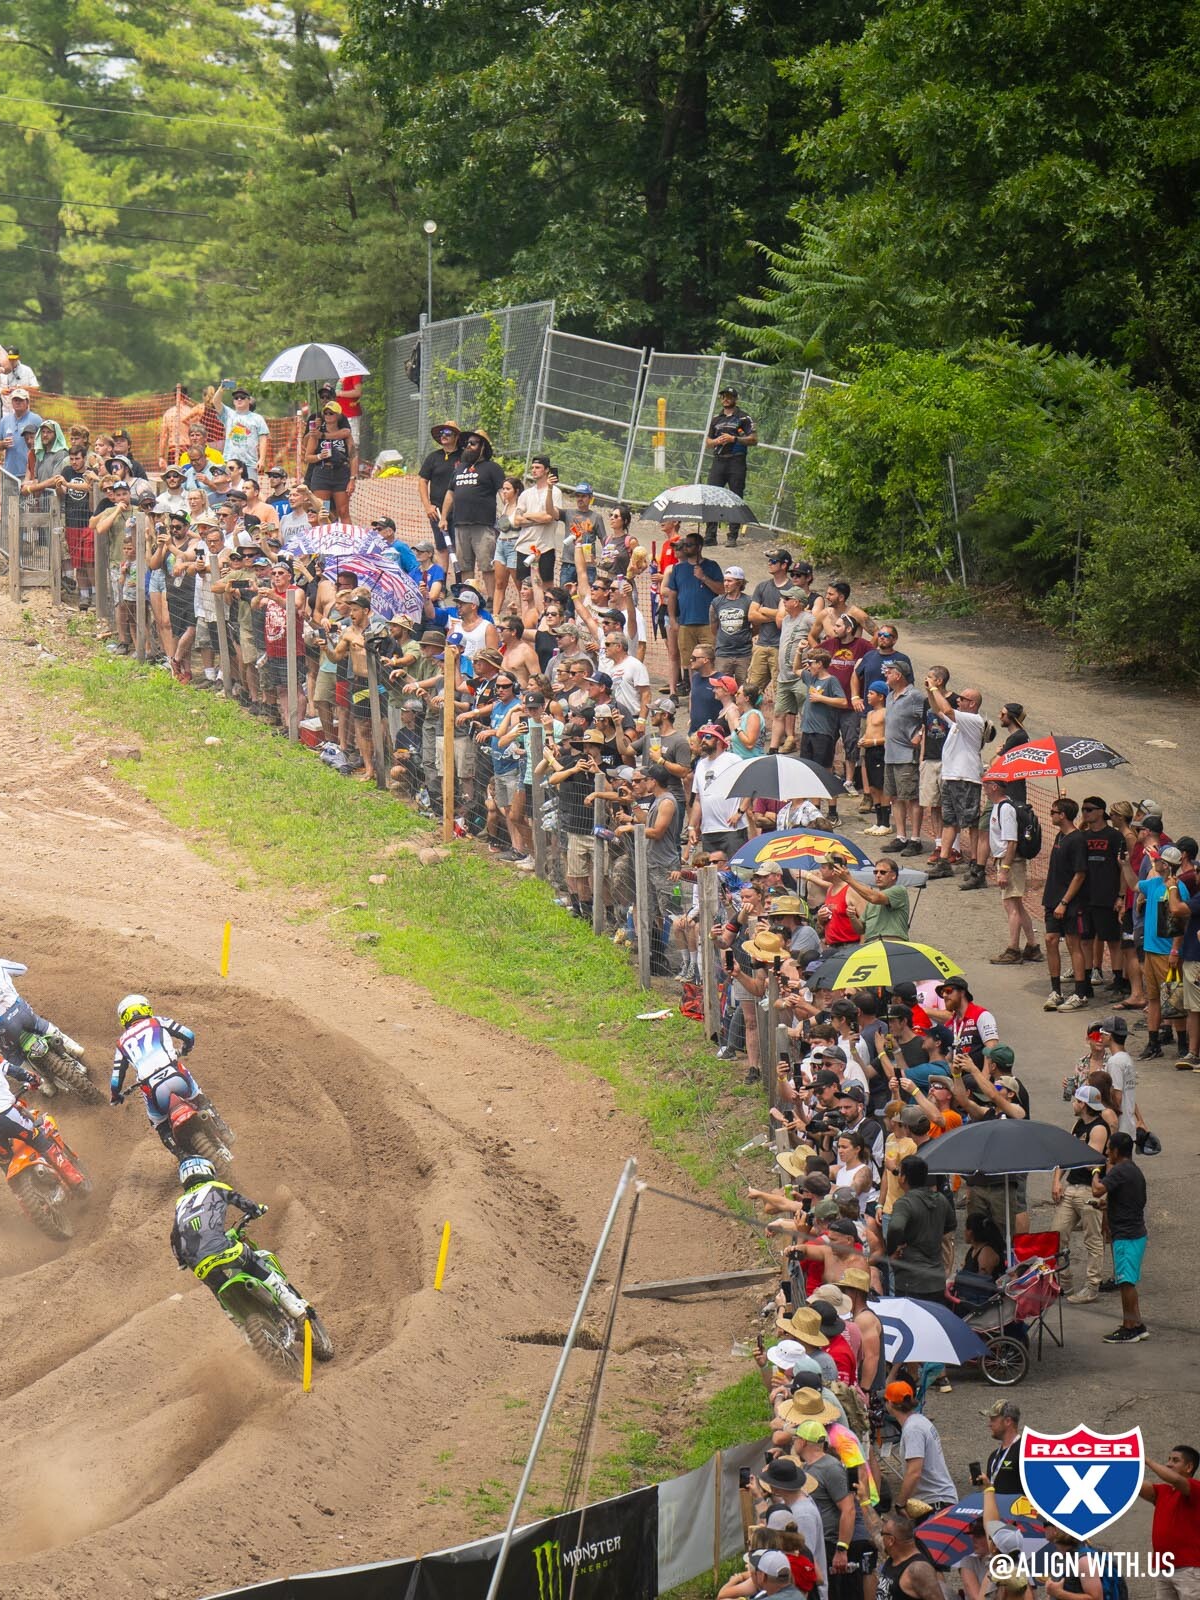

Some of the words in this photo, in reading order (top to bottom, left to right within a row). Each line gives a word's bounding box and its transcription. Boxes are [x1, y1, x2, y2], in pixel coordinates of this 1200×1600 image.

[455, 472, 479, 480] moto
[846, 964, 879, 983] 5
[122, 1026, 154, 1060] 87
[563, 1535, 621, 1567] MONSTER
